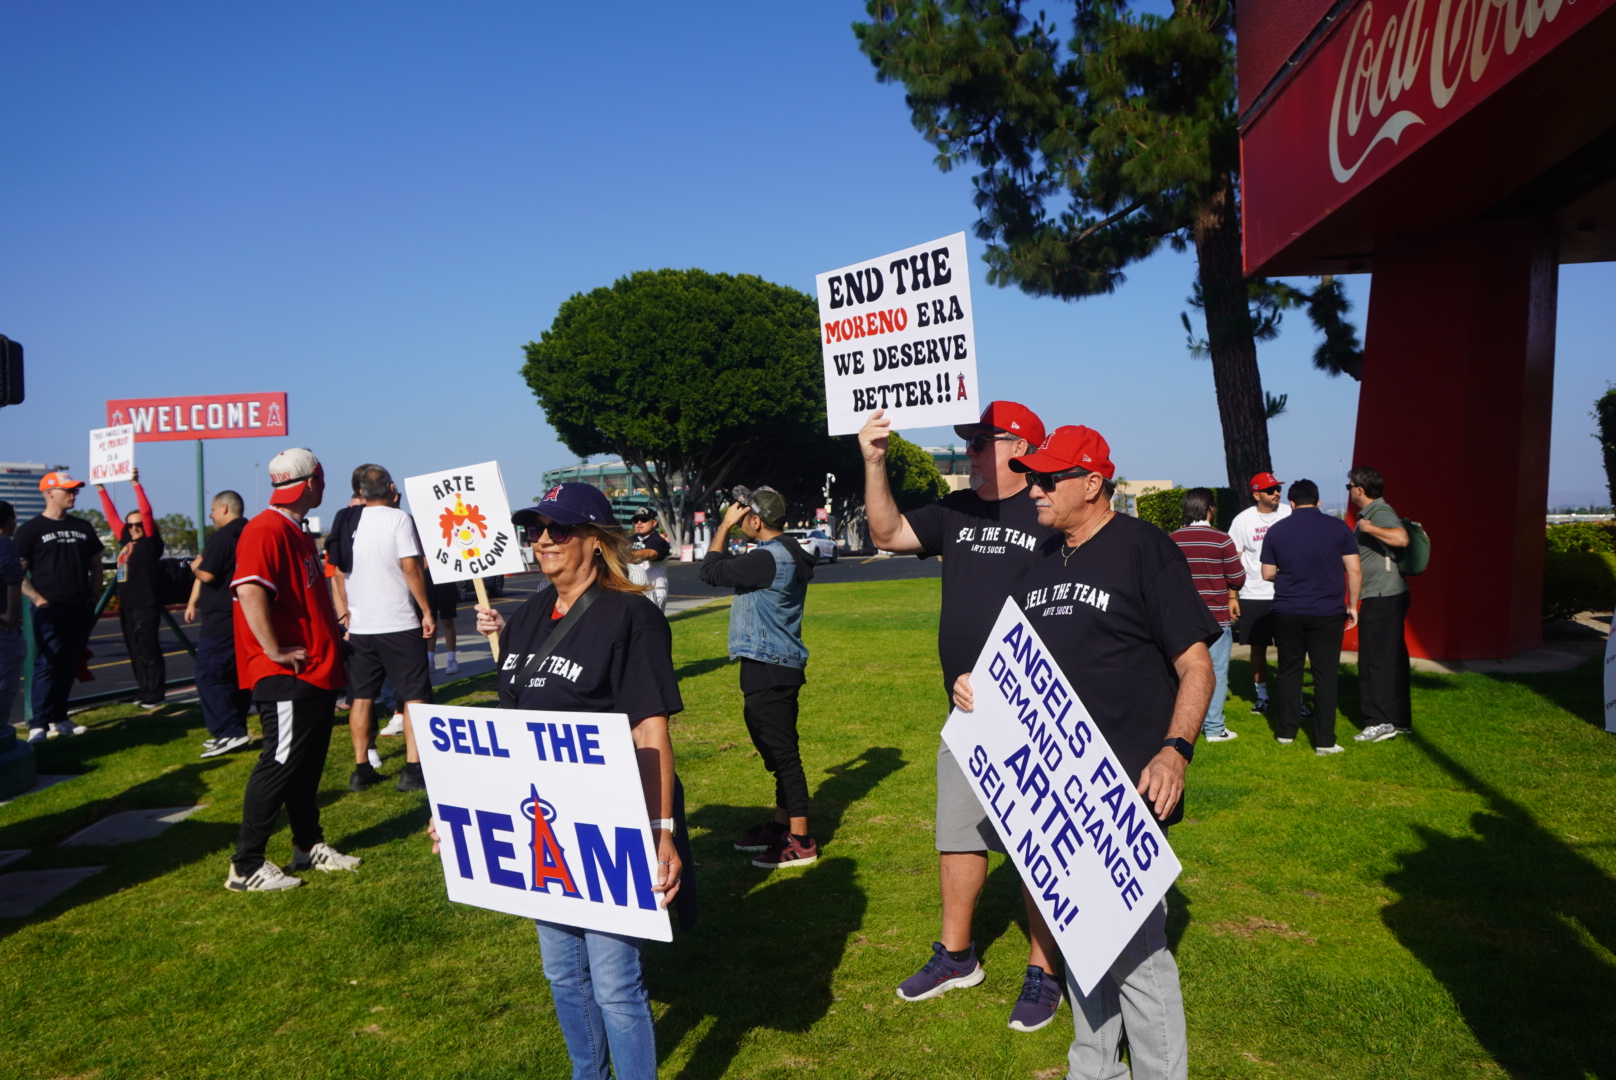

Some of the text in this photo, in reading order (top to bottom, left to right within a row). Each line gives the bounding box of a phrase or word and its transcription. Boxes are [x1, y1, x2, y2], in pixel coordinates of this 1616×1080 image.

[828, 247, 952, 309] END THE
[825, 295, 964, 344] MORENO ERA
[833, 334, 967, 377] WE DESERVE
[127, 401, 262, 434] WELCOME
[92, 459, 130, 480] NEW OWNER
[432, 476, 475, 500] ARTE
[436, 531, 508, 574] IS A CLOWN
[980, 527, 1001, 542] THE
[1004, 528, 1037, 552] TEAM
[987, 546, 1006, 554] SUCKS
[1025, 583, 1111, 612] SELL THE TEAM
[1055, 605, 1074, 616] SUCKS
[547, 655, 584, 683] TEAM
[429, 716, 606, 765] SELL THE
[1002, 621, 1159, 871] ANGELS FANS
[988, 651, 1144, 911] DEMAND CHANGE
[1003, 743, 1084, 877] ARTE.
[437, 783, 658, 911] TEAM
[969, 744, 1079, 933] SELL NOW!
